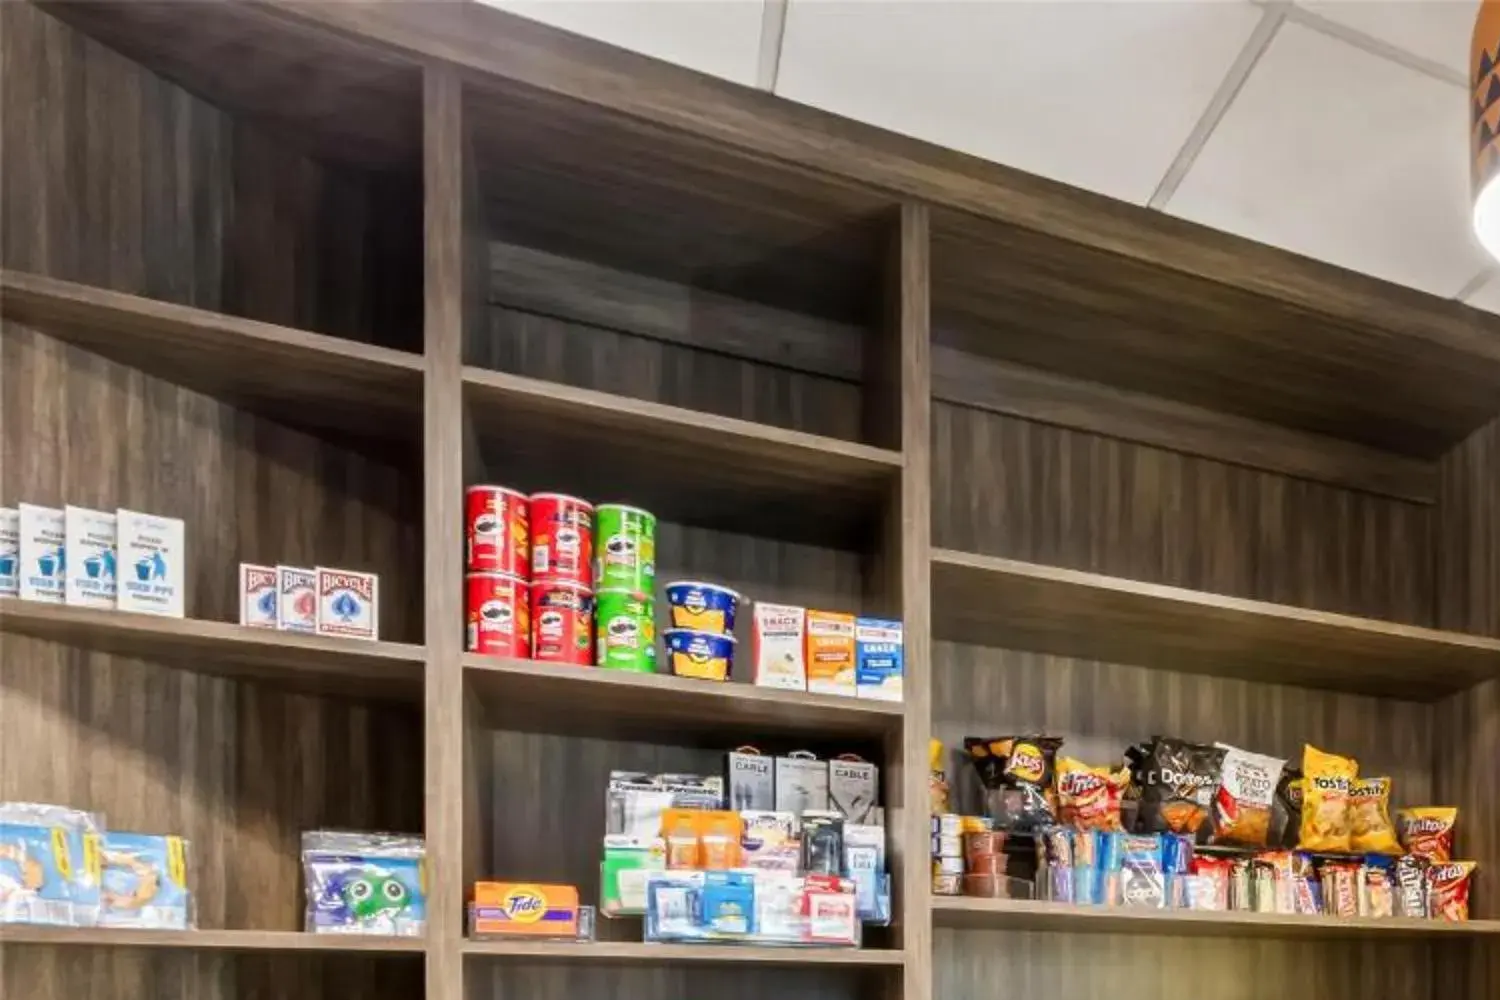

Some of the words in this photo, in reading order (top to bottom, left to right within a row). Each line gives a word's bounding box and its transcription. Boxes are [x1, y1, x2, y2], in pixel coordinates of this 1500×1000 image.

[248, 571, 275, 589] BICY
[322, 573, 372, 599] BICYCLE
[1161, 767, 1213, 785] Doritos
[508, 895, 542, 913] Tide
